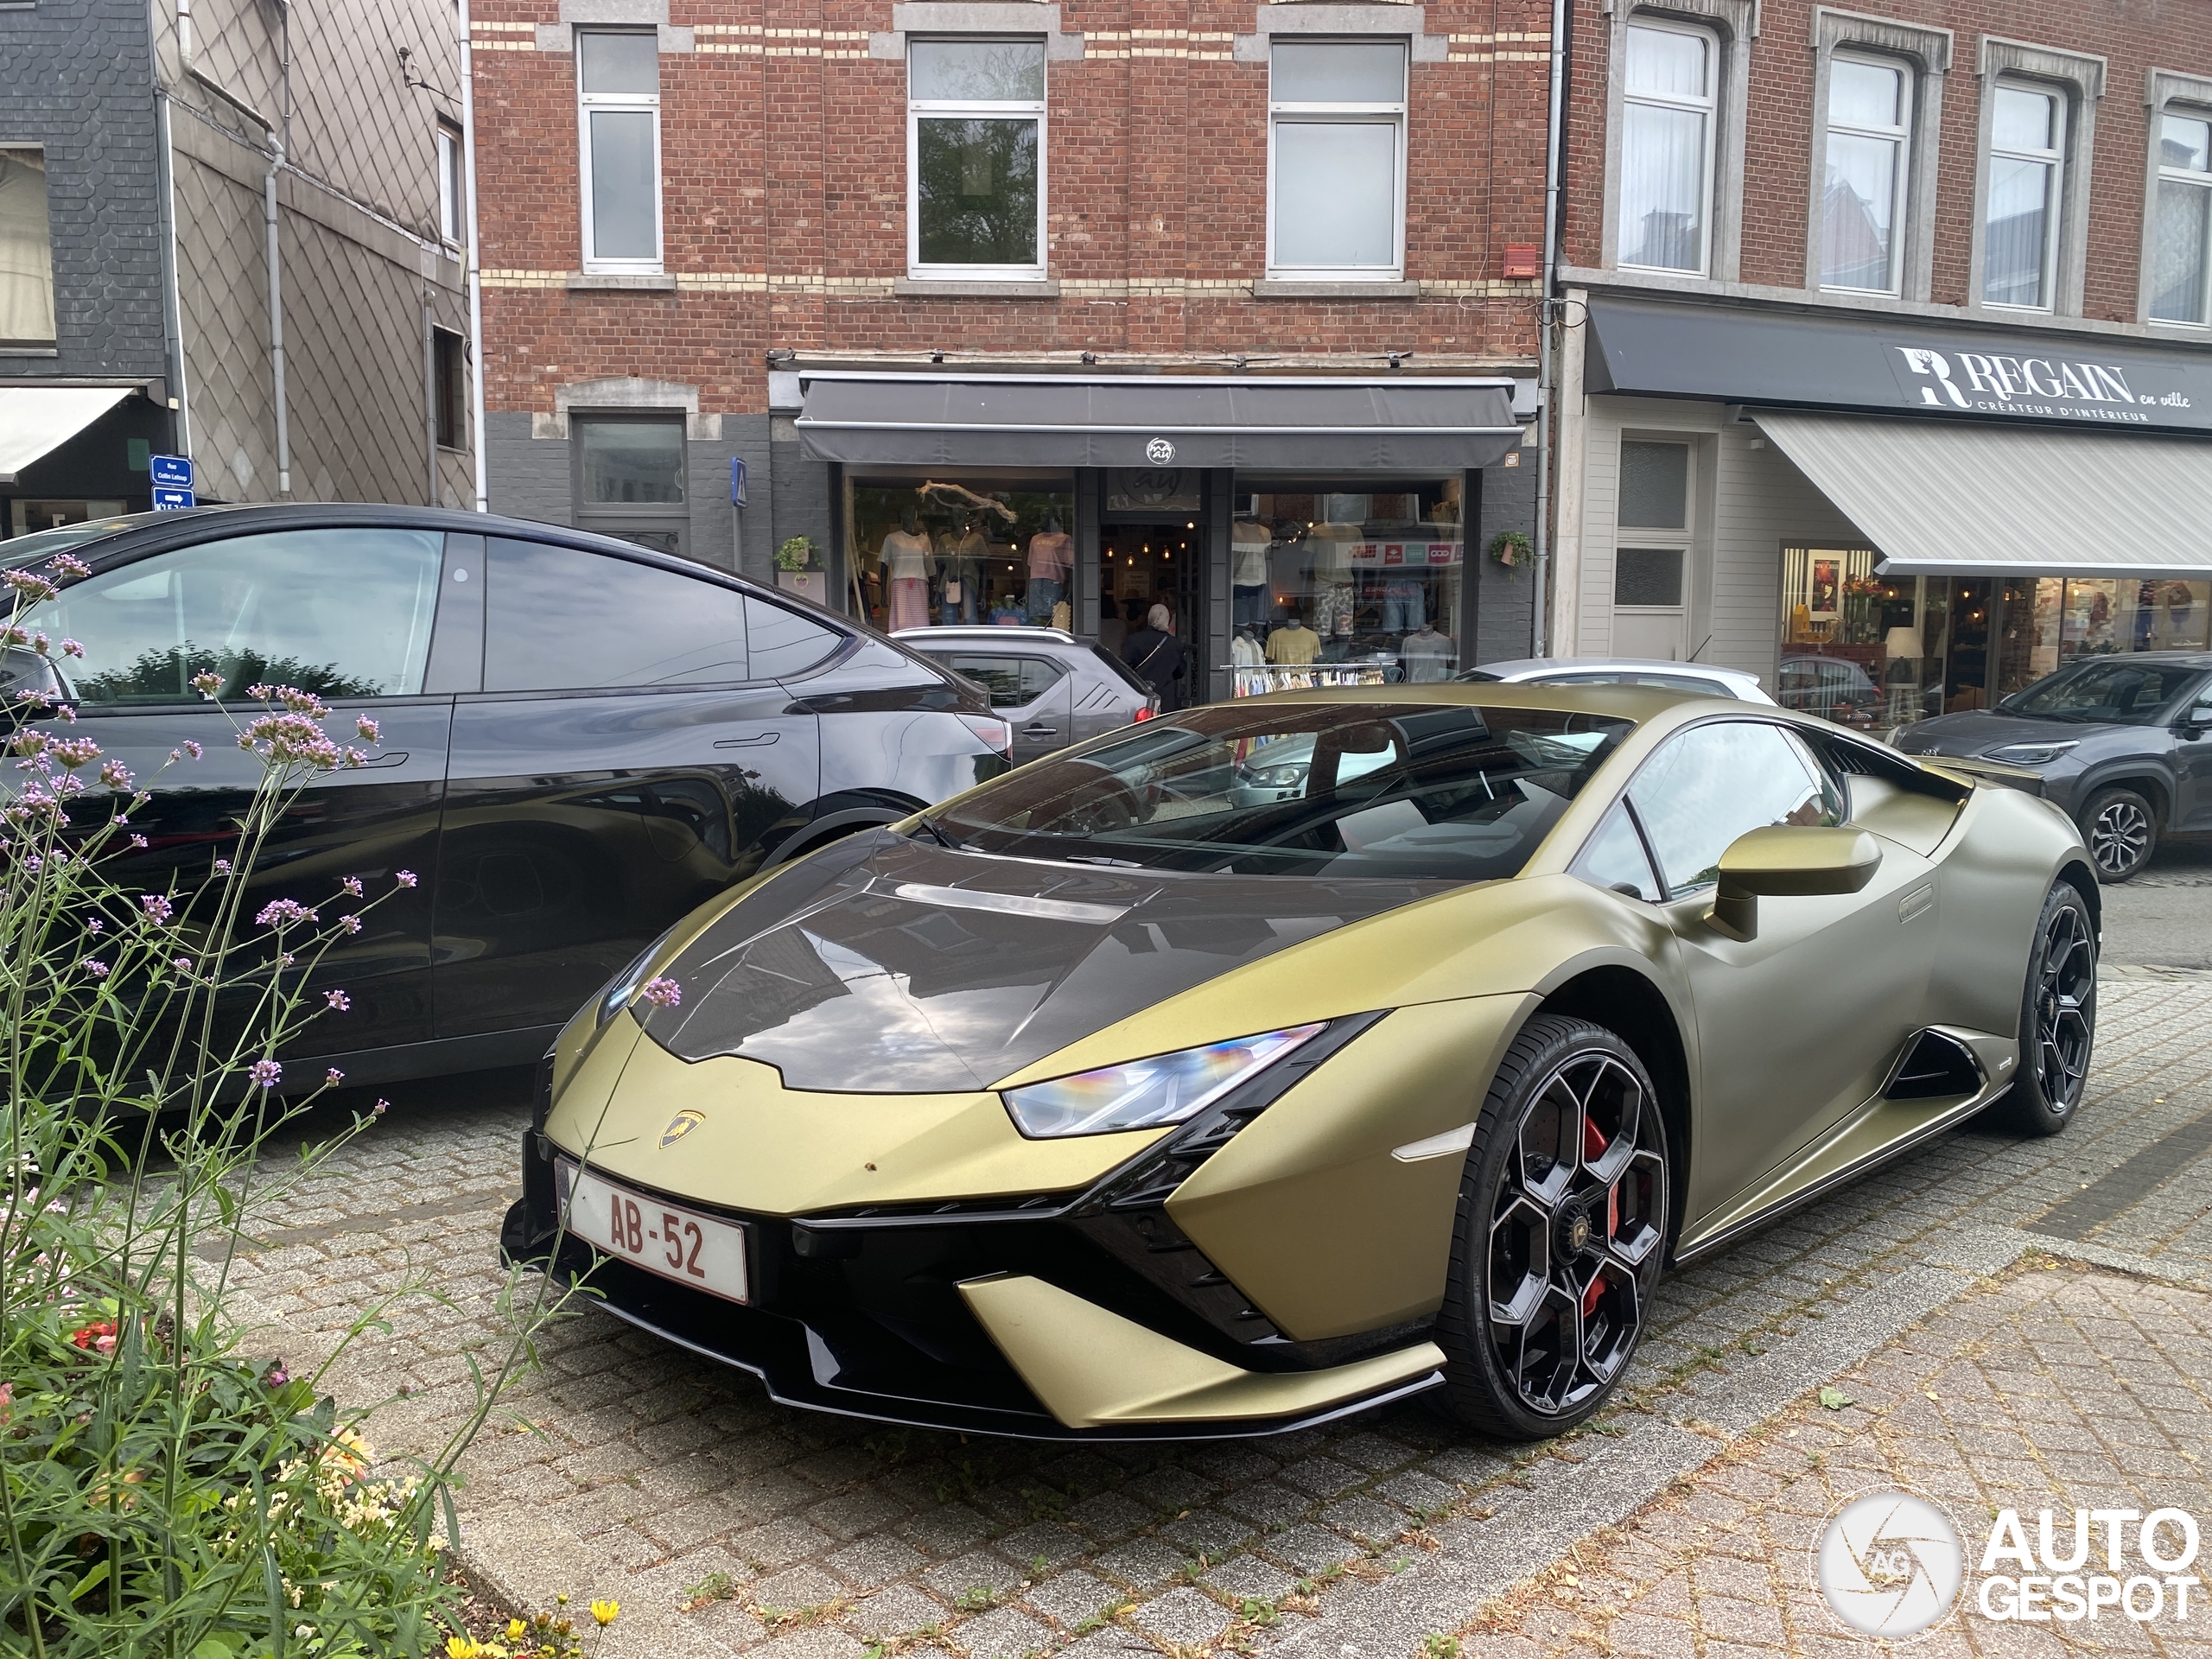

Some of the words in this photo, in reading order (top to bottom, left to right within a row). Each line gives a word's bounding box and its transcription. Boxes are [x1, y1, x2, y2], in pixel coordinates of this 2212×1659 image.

[1955, 353, 2135, 404] REGAIN
[2139, 394, 2157, 406] en
[2160, 391, 2191, 409] ville
[1977, 400, 2054, 416] CRÉATEUR
[2060, 407, 2150, 423] D'INTÉRIEUR
[611, 1193, 705, 1279] AB-52
